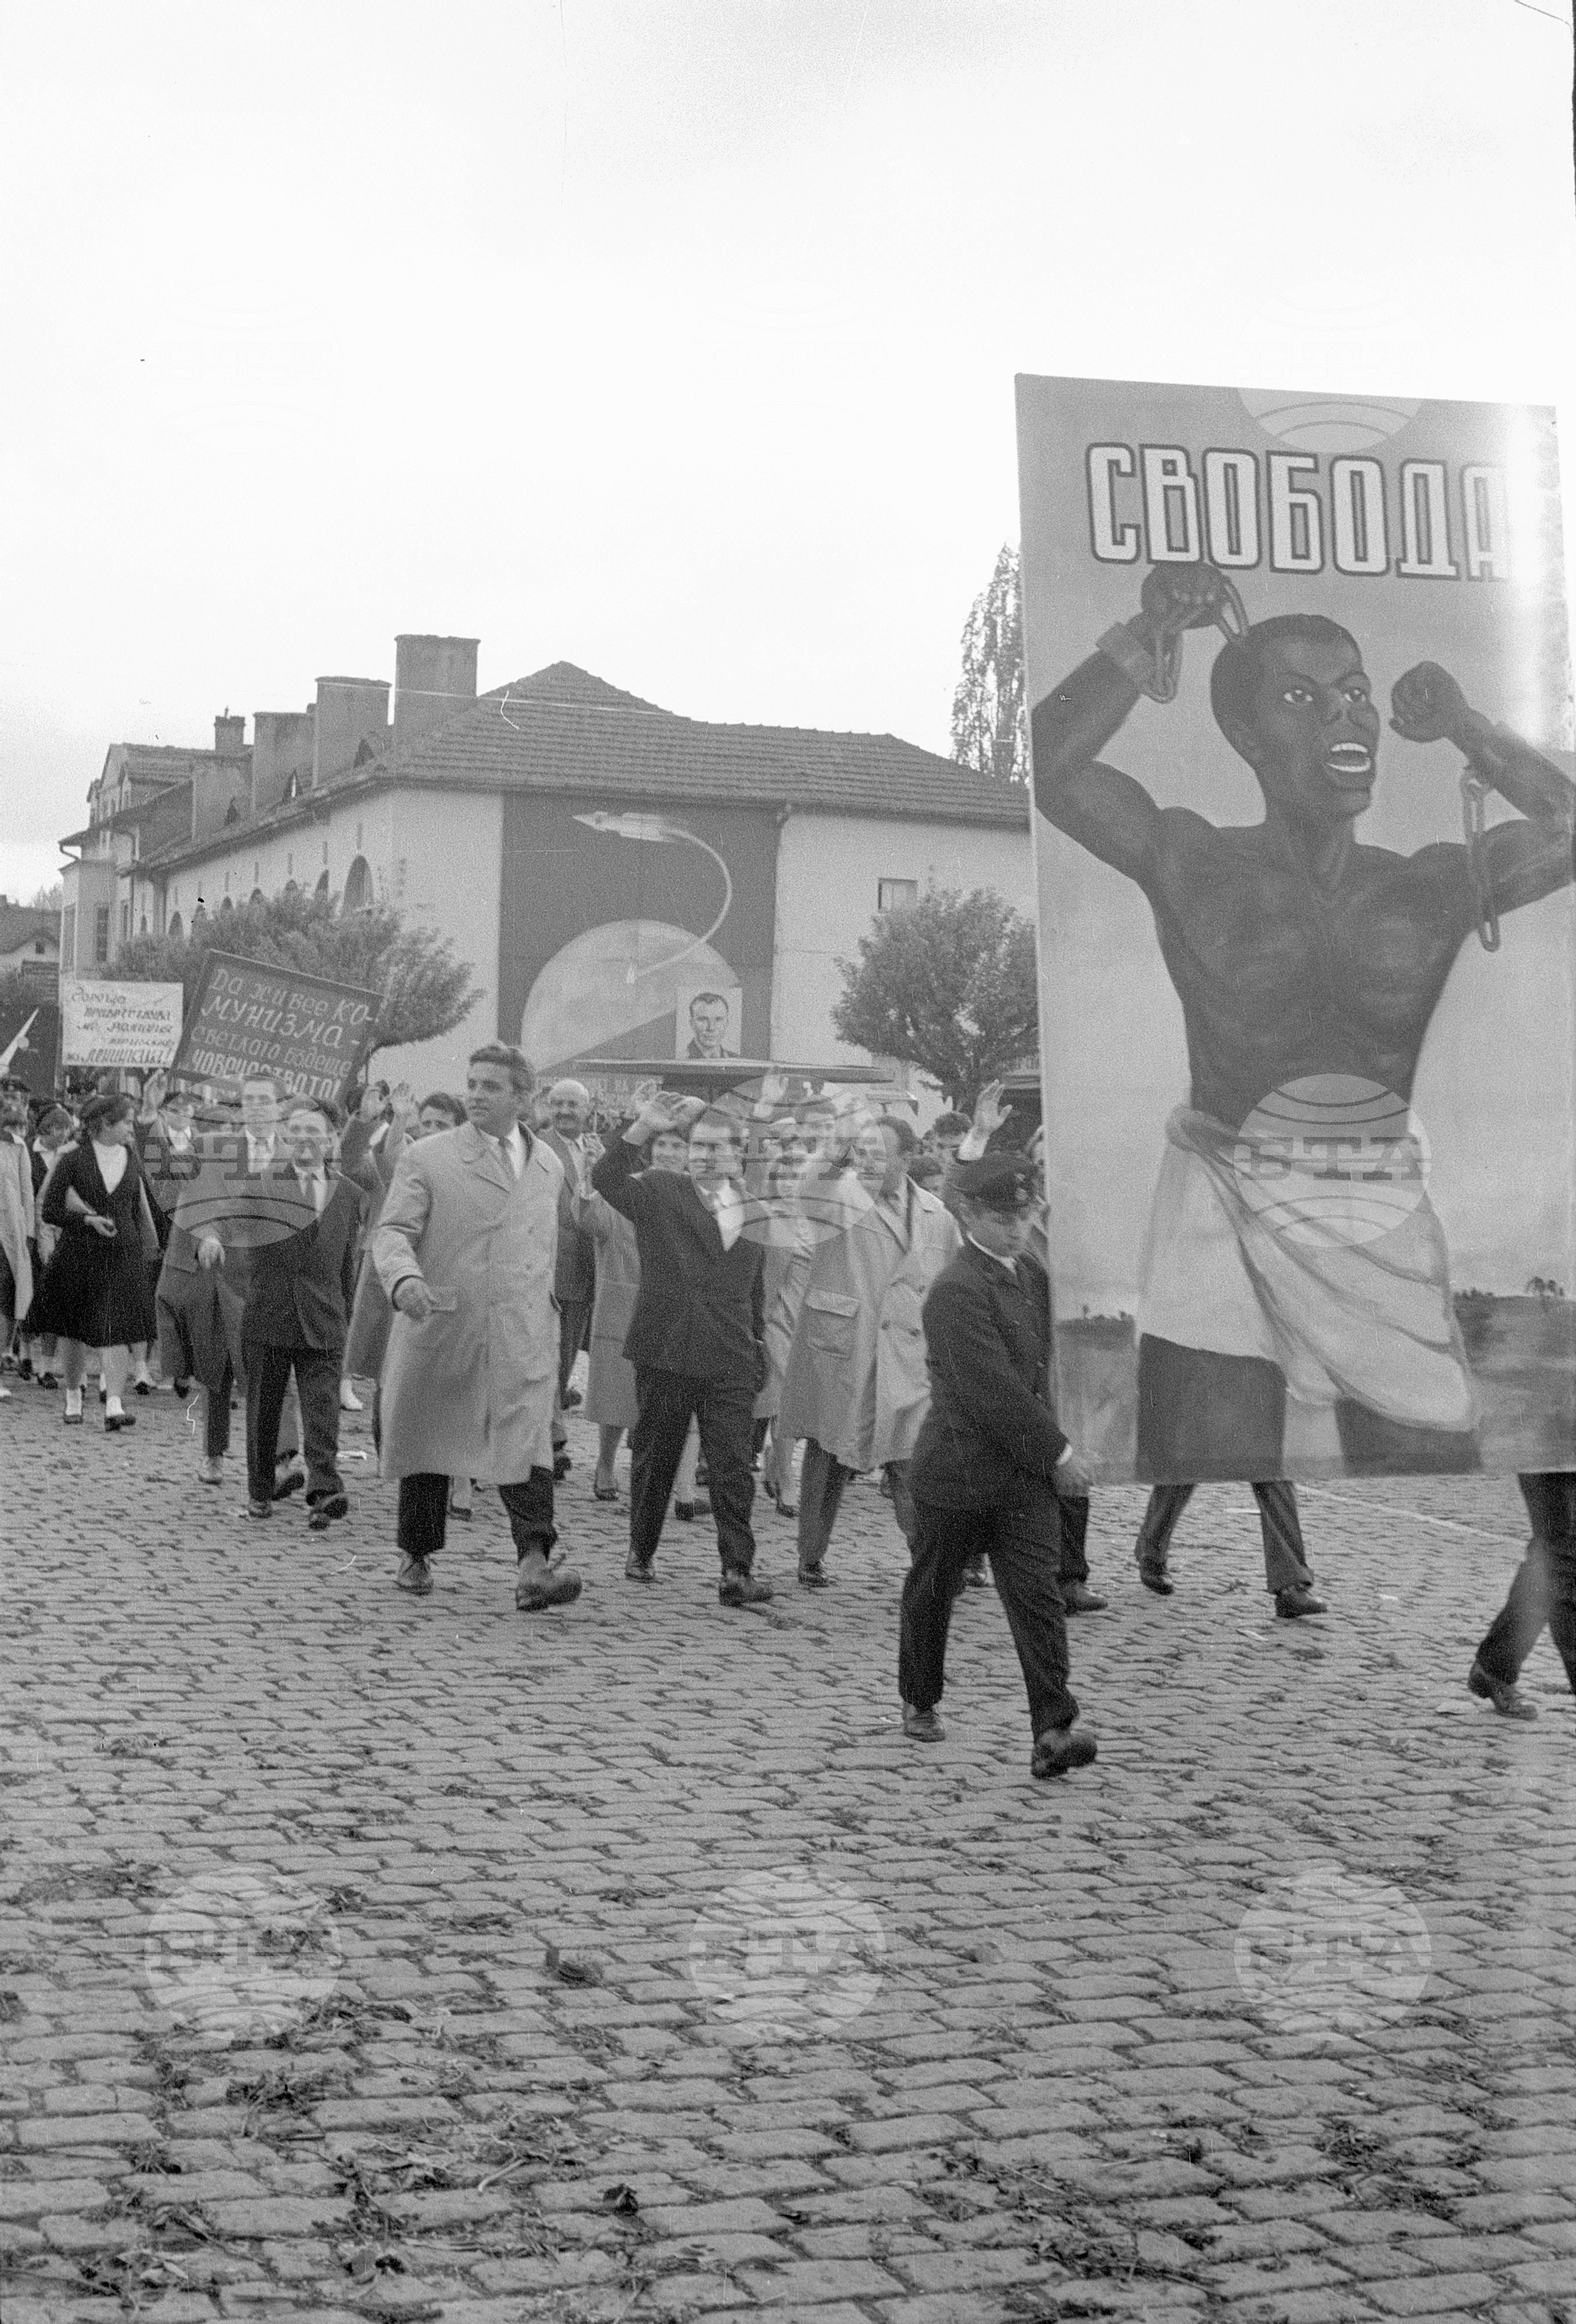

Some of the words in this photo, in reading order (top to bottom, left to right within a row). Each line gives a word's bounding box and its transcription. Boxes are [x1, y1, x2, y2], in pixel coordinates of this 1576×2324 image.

[1085, 442, 1509, 582] СВОБОДА
[208, 968, 243, 995] Да
[249, 982, 329, 1017] живее
[191, 1025, 282, 1060] светлото
[201, 995, 343, 1049] МУНИЗМА
